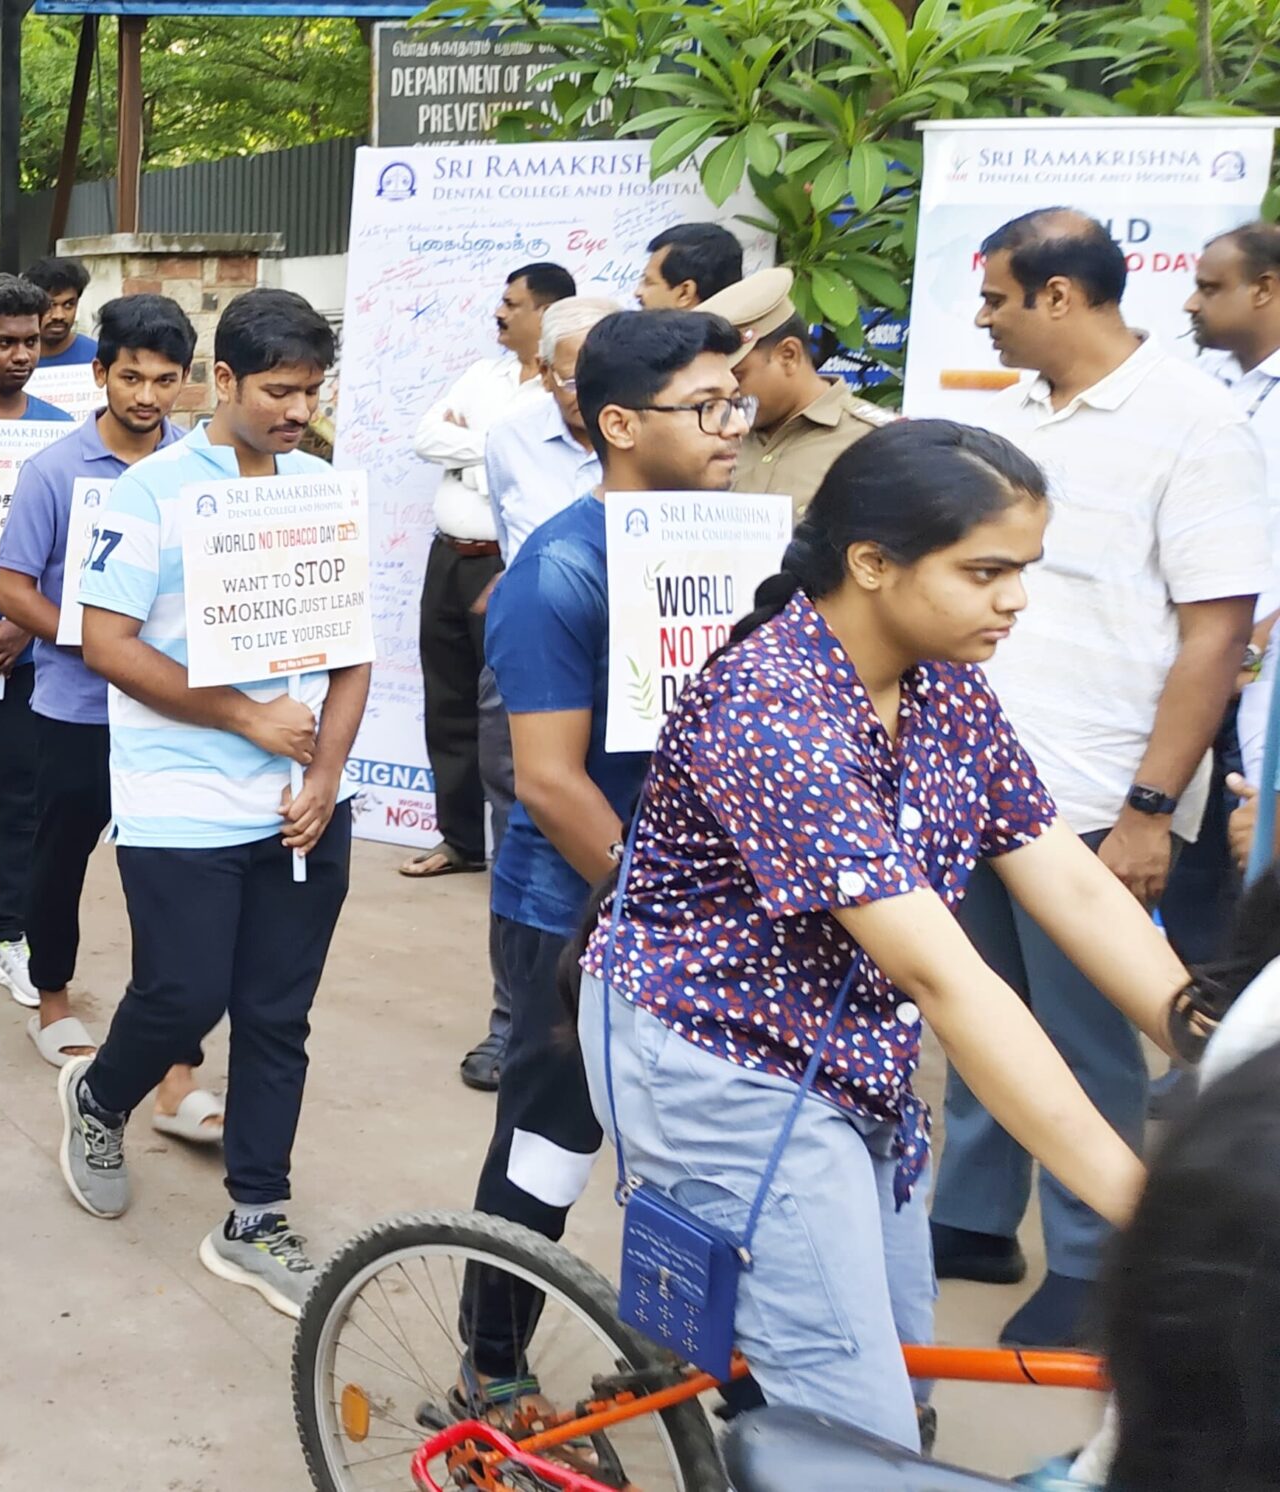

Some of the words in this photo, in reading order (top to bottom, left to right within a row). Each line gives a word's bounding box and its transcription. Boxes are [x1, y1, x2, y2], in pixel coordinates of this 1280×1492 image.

[390, 63, 502, 97] DEPARTMENT
[503, 63, 522, 94] OF
[418, 100, 533, 135] PREVENT
[433, 157, 473, 180] SRI
[485, 153, 700, 179] RAMAKRISHA
[978, 149, 1014, 168] SRI
[1023, 148, 1201, 167] RAMAKRISHNA
[432, 187, 493, 201] DENTAL
[498, 184, 575, 199] COLLEGE
[575, 184, 612, 198] AND
[620, 181, 701, 198] HOSPITAL
[978, 171, 1031, 184] DENTAL
[1033, 170, 1097, 184] COLLEGE
[1099, 172, 1133, 184] AND
[1135, 171, 1201, 184] HOSPITAL
[567, 229, 608, 255] Bye
[226, 488, 250, 505] SRI
[255, 483, 344, 502] RAMAKRISHNA
[228, 507, 261, 519] DENTAL
[263, 504, 297, 517] COLLEGE
[660, 502, 686, 523] SRI
[213, 531, 256, 554] WORLD
[258, 530, 273, 550] NO
[276, 526, 318, 548] TOBACCO
[319, 524, 336, 544] DAY
[222, 575, 269, 594] WANT
[272, 573, 291, 589] TO
[294, 558, 346, 587] STOP
[203, 597, 297, 626] SMOKING
[298, 596, 328, 614] JUST
[330, 591, 365, 609] LEARN
[656, 574, 734, 618] WORLD
[231, 634, 253, 651] TO
[257, 630, 288, 649] LIVE
[292, 620, 352, 644] YOURSELF
[659, 625, 694, 668] NO
[344, 759, 435, 792] SIGNA
